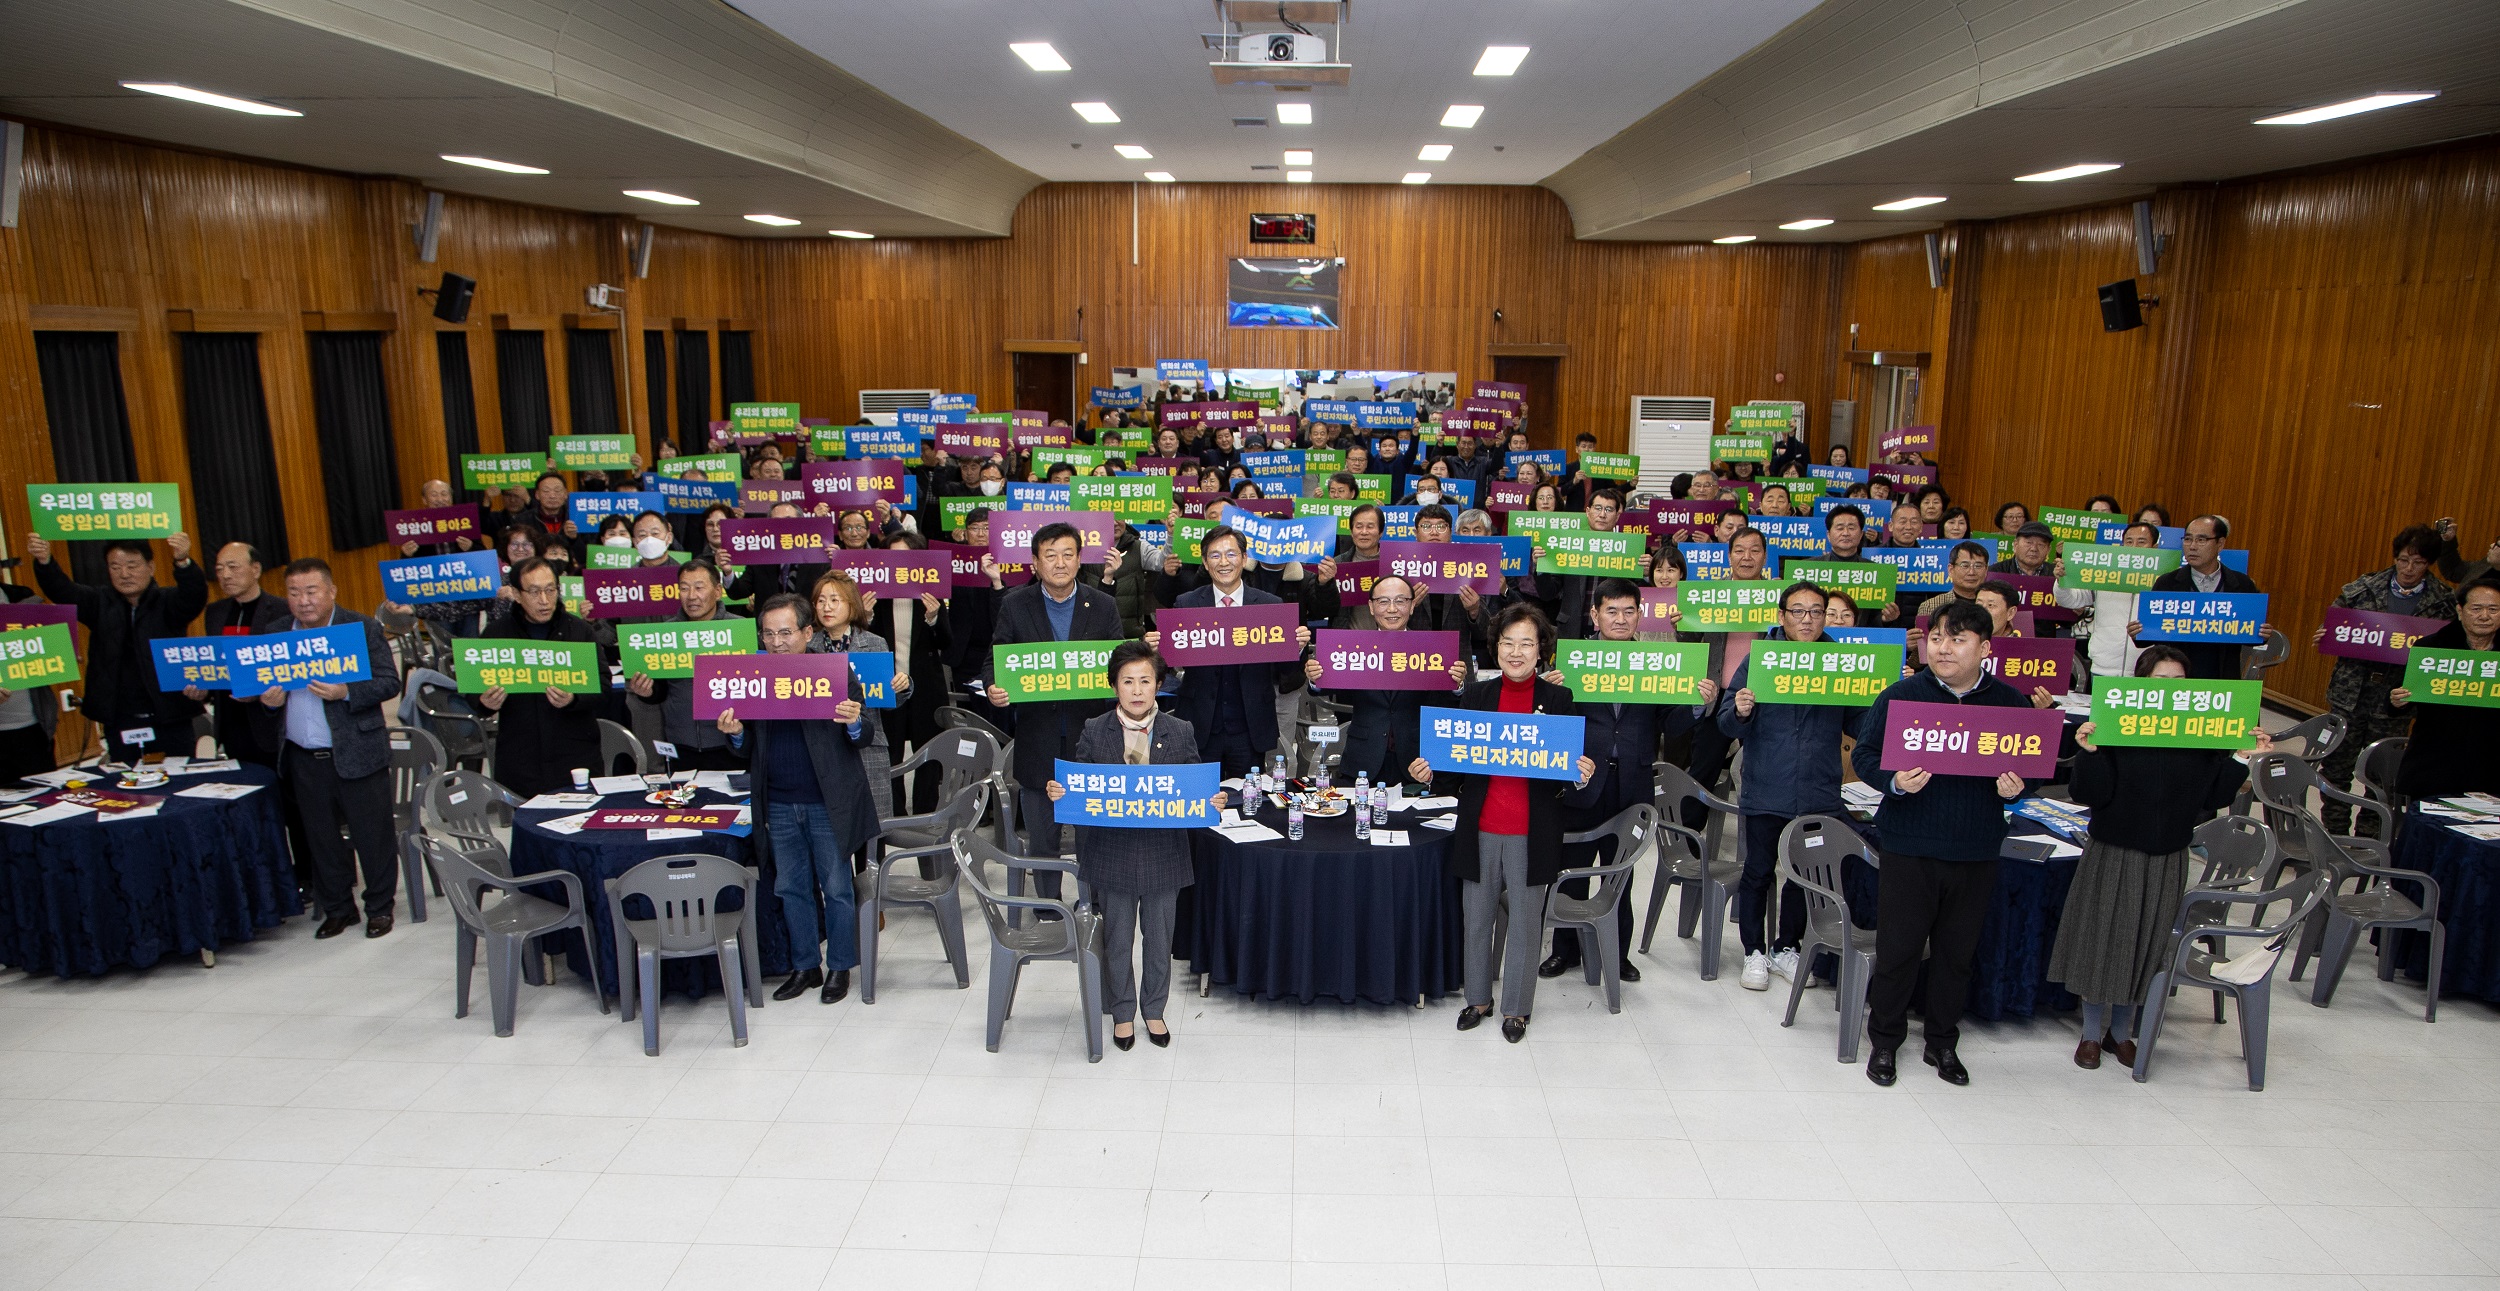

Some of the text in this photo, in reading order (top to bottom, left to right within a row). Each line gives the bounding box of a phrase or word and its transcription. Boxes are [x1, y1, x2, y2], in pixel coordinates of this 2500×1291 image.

[1167, 370, 1204, 378] 주민자치에서
[1096, 390, 1132, 399] 변화의 시작,
[1233, 389, 1250, 397] 우리의
[1478, 388, 1520, 400] 영암이 좋아요
[1101, 397, 1139, 405] 주민자치에서
[1311, 403, 1347, 412] 변화의 시작,
[735, 407, 787, 417] 우리의 열정이
[1206, 410, 1254, 420] 영암이 좋아요
[1360, 405, 1402, 415] 변화의 시작,
[1735, 410, 1781, 418] 우리의 열정이
[741, 418, 794, 428] 영암의 미래다
[1022, 418, 1043, 427] 좋아요
[1366, 416, 1411, 424] 주민자치에서
[1447, 419, 1496, 430] 영암이 좋아요
[1740, 419, 1786, 428] 영암의 미래다
[851, 431, 904, 442] 변화의 시작,
[942, 434, 1000, 447] 영암이 좋아요
[1018, 435, 1066, 445] 영암이 좋아요
[1715, 439, 1762, 448] 우리의 열정이
[1883, 435, 1928, 450] 영암이 좋아요
[556, 440, 620, 452] 우리의 열정이
[860, 443, 915, 453] 주민자치에서
[565, 452, 630, 465] 영암의 미래다
[1038, 452, 1091, 465] 우리의 열정이
[1246, 455, 1290, 466] 변화의 시작,
[1313, 453, 1335, 461] 열정이
[1720, 449, 1768, 459] 영암의 미래다
[468, 458, 531, 471] 우리의 열정이
[663, 459, 726, 473] 우리의 열정이
[1585, 456, 1630, 467] 우리의 열정이
[1254, 464, 1300, 475] 주민자치에서
[1591, 466, 1635, 476] 영암의 미래다
[1812, 469, 1853, 480] 변화의 시작,
[659, 483, 716, 497] 변화의 시작,
[812, 476, 895, 493] 영암이 좋아요
[1078, 483, 1155, 497] 우리의 열정이
[1789, 482, 1814, 492] 열정이
[40, 492, 153, 510] 우리의 열정이
[576, 498, 643, 512] 변화의 시작,
[1497, 493, 1523, 504] 영암이
[1088, 499, 1165, 513] 영암의 미래다
[56, 512, 170, 531] 영암의 미래다
[1515, 517, 1580, 529] 우리의 열정이
[1657, 512, 1689, 524] 영암이
[396, 518, 472, 535] 영암이 좋아요
[1232, 515, 1307, 540] 변화의 시작,
[732, 534, 823, 551] 영암이 좋아요
[1547, 536, 1626, 553] 우리의 열정이
[1556, 553, 1636, 570] 영암의 미래다
[1687, 550, 1724, 563] 변화의
[2071, 550, 2159, 570] 우리의 열정이
[390, 561, 472, 582] 변화의 시작,
[895, 568, 940, 584] 좋아요
[1392, 560, 1488, 578] 영암이 좋아요
[1793, 568, 1877, 584] 우리의 열정이
[407, 576, 492, 597] 주민자치에서
[1687, 589, 1780, 604] 우리의 열정이
[1847, 587, 1887, 601] 미래다
[2150, 600, 2236, 618] 변화의 시작,
[2161, 619, 2254, 635] 주민자치에서
[629, 629, 732, 650] 우리의 열정이
[1172, 626, 1285, 649] 영암이 좋아요
[163, 645, 215, 663] 변화의
[236, 637, 335, 661] 변화의 시작,
[465, 648, 571, 666] 우리의 열정이
[1005, 651, 1056, 671] 우리의
[1330, 651, 1444, 672] 영암이 좋아요
[1568, 650, 1681, 671] 우리의 열정이
[1761, 651, 1875, 672] 우리의 열정이
[8, 655, 64, 679] 미래다
[256, 659, 358, 684] 주민자치에서
[2419, 657, 2474, 676] 우리의
[480, 668, 588, 686] 영암의 미래다
[1582, 674, 1694, 694] 영암의 미래다
[709, 677, 832, 699] 영암이 좋아요
[1774, 675, 1827, 694] 영암의
[2105, 688, 2232, 712] 우리의 열정이
[1434, 719, 1544, 747] 변화의 시작,
[2119, 715, 2245, 738] 영암의 미래다
[1903, 728, 2041, 756] 영암이 좋아요
[1451, 744, 1568, 770] 주민자치에서
[1067, 774, 1180, 796] 변화의 시작,
[1086, 798, 1205, 818] 주민자치에서
[665, 815, 718, 823] 좋아요
